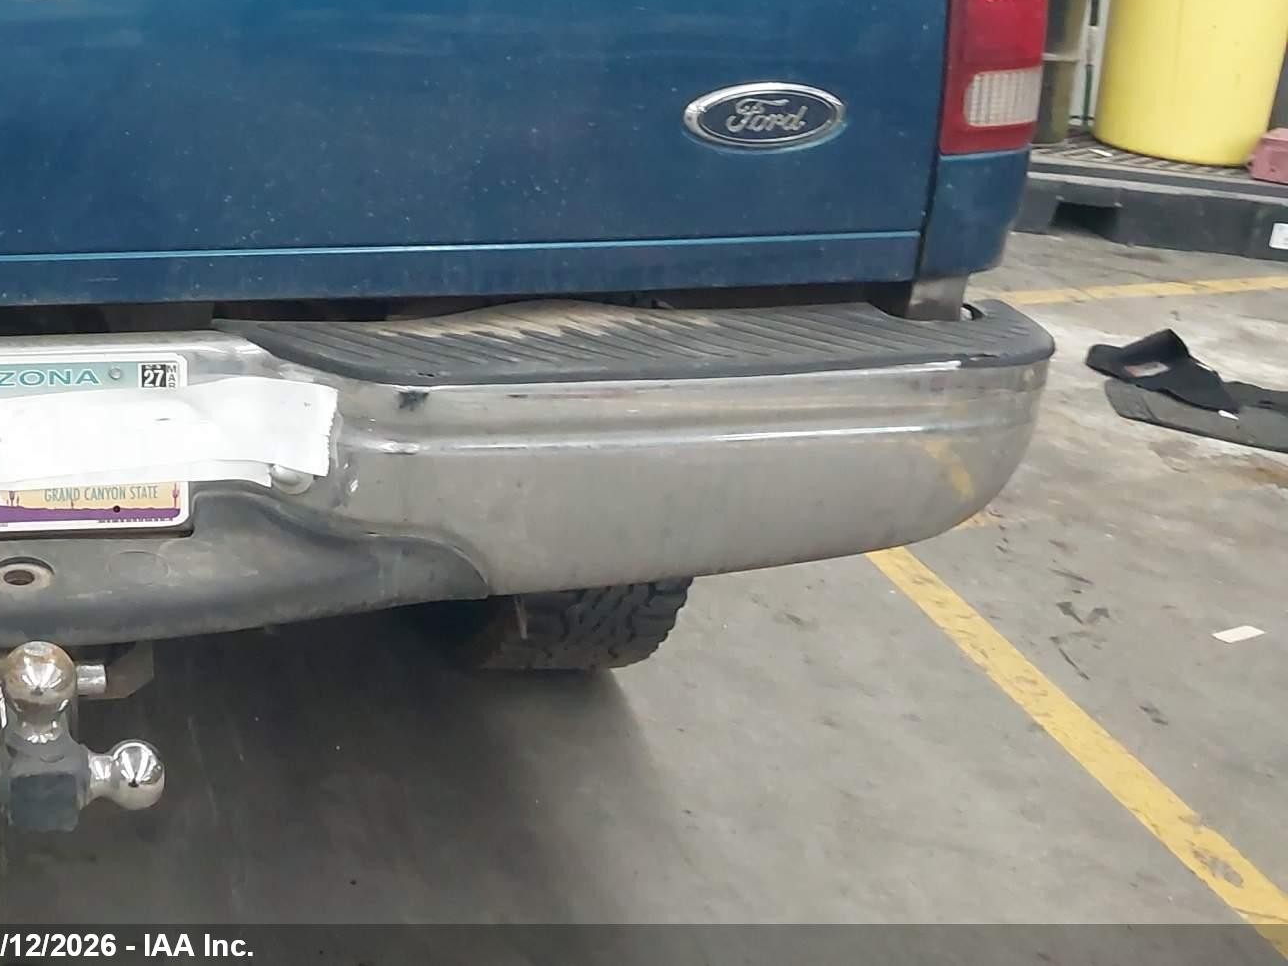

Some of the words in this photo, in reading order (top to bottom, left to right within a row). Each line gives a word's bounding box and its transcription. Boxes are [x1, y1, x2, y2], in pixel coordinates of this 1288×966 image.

[725, 97, 809, 133] Ford
[143, 369, 165, 387] 27
[44, 488, 80, 502] GRAND
[84, 486, 126, 501] CANYON
[129, 485, 159, 500] STATE
